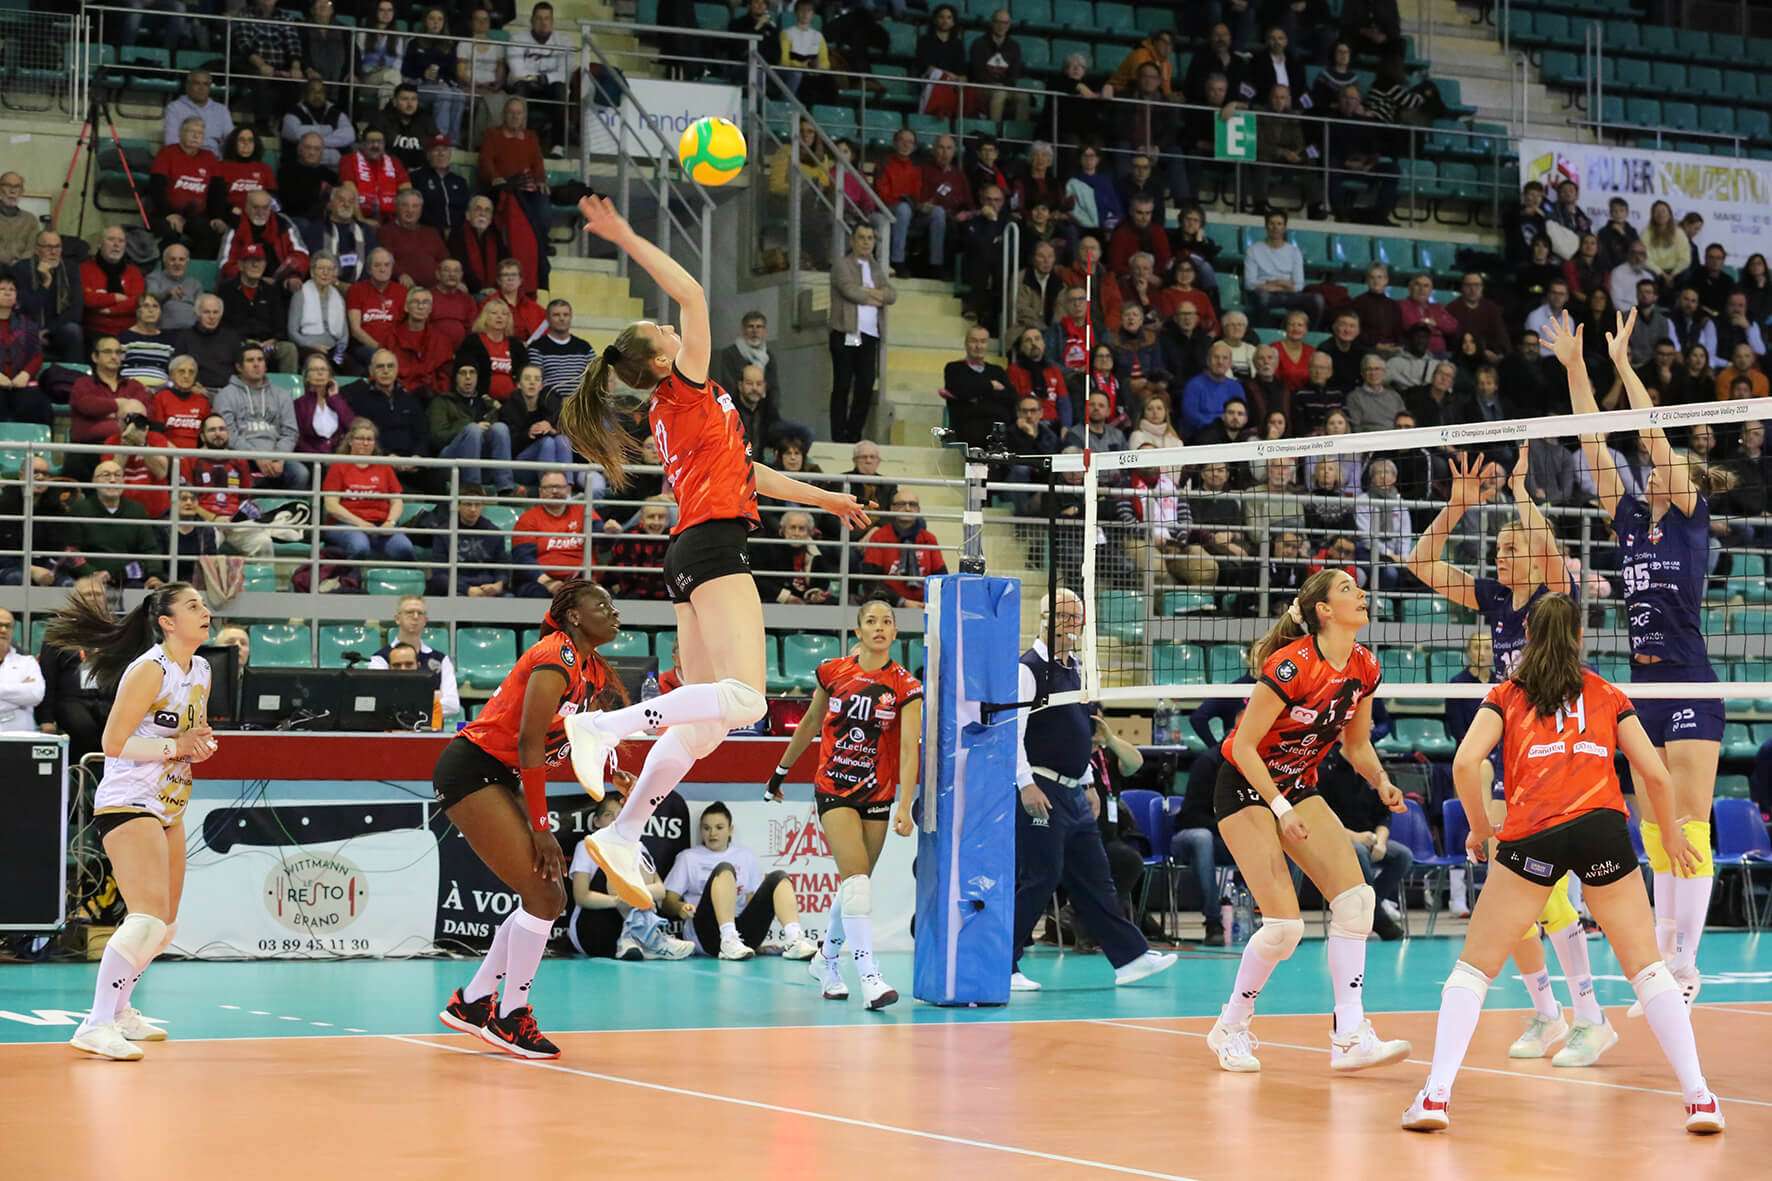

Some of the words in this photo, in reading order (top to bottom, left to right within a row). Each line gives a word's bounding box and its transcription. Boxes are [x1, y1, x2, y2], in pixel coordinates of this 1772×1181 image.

[1226, 116, 1245, 155] E
[847, 693, 872, 721] 20
[1323, 699, 1338, 726] 5
[187, 704, 195, 729] 9
[835, 739, 877, 754] E.Leclerc
[832, 754, 873, 769] Mulhouse
[284, 859, 349, 876] WITTMANN
[1584, 862, 1620, 879] AVENUE
[1591, 860, 1614, 872] CAR
[288, 882, 344, 906] RESTO
[442, 880, 464, 910] À
[797, 894, 836, 913] BRA
[294, 912, 340, 928] BRAND
[443, 919, 489, 937] DANS
[258, 939, 277, 951] 03
[282, 939, 301, 951] 89
[306, 939, 324, 951] 45
[331, 939, 345, 950] 11
[351, 939, 369, 950] 30
